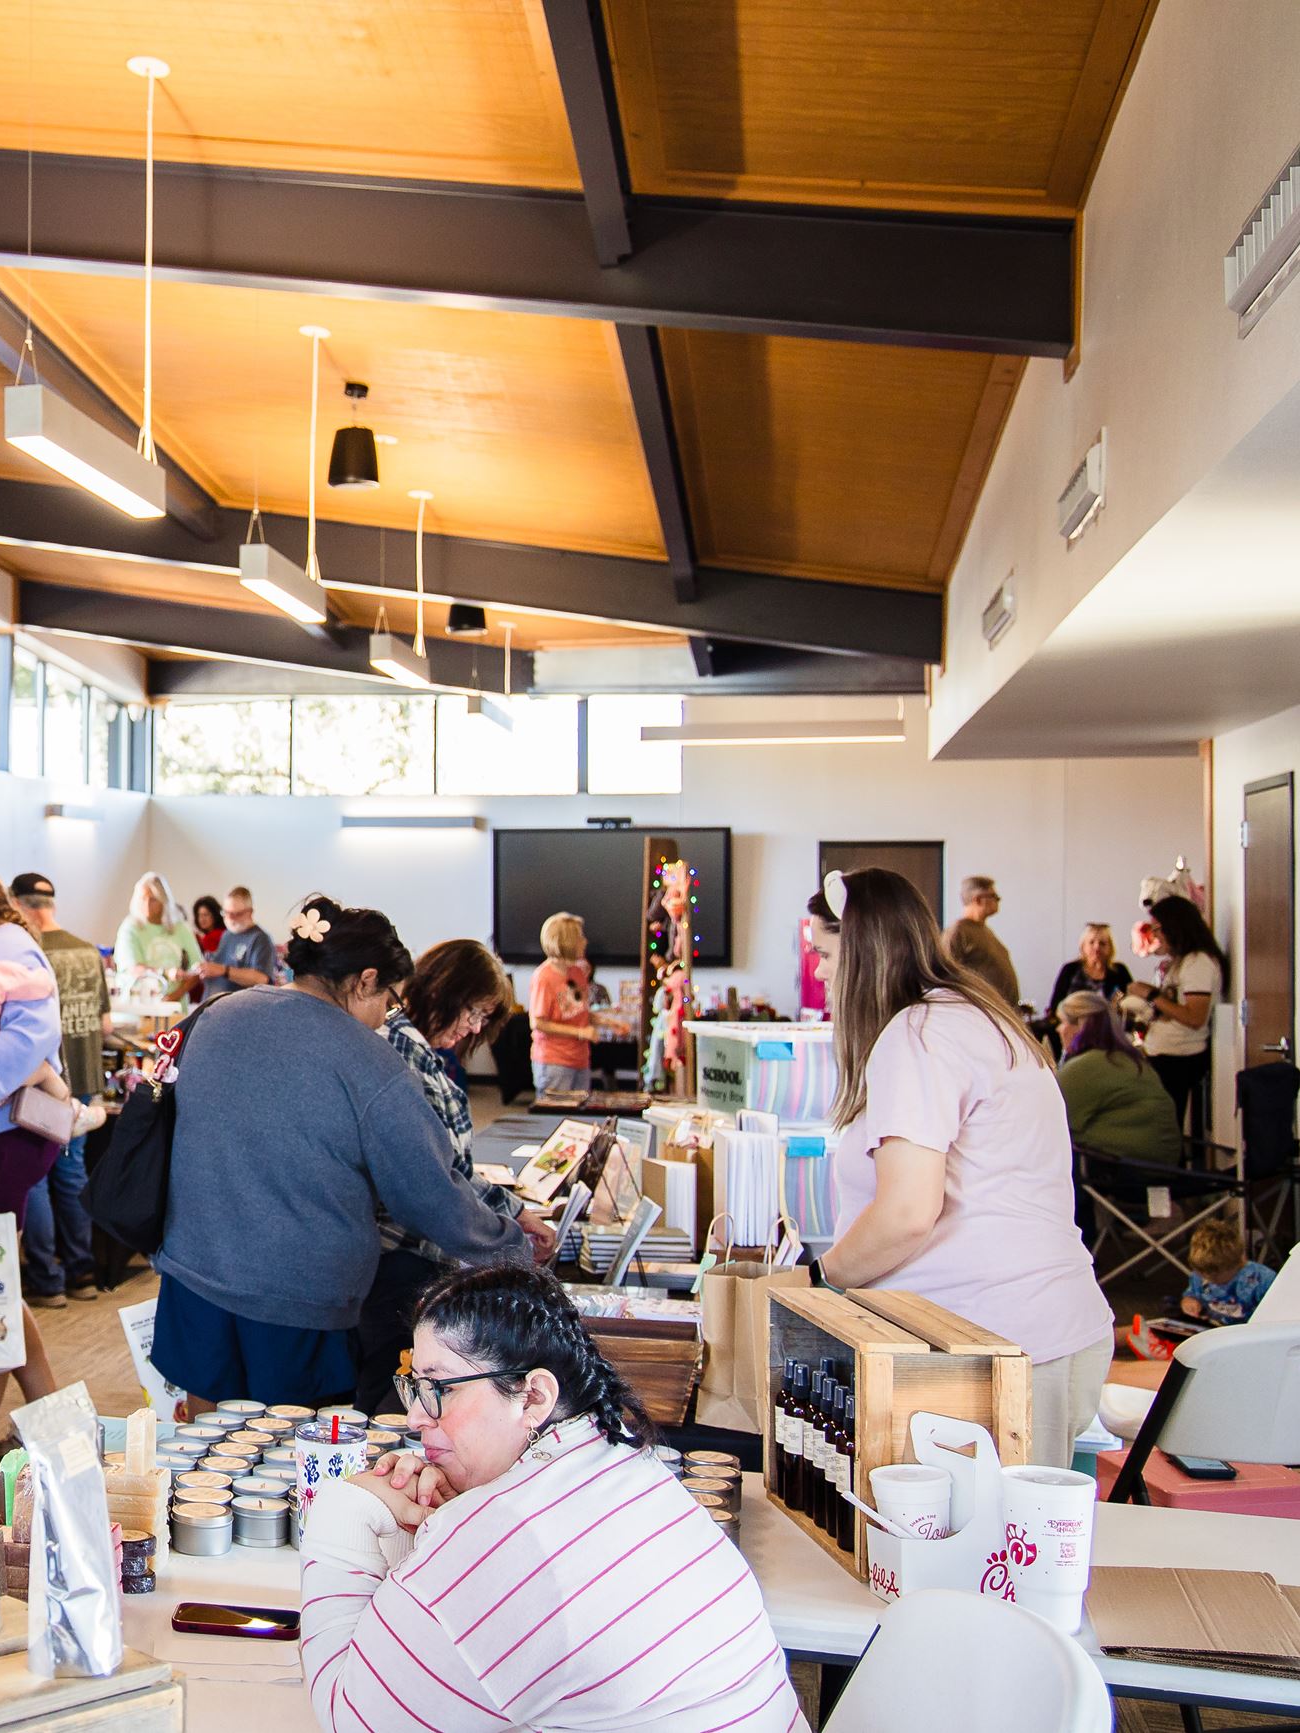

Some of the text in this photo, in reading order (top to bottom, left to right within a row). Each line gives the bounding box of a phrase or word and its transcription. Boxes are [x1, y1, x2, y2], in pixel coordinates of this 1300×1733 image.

[716, 1051, 726, 1064] My
[703, 1067, 742, 1085] SCHOOL
[730, 1090, 744, 1103] Box
[909, 1516, 925, 1528] SHARE
[1047, 1520, 1083, 1530] EVERGREEN
